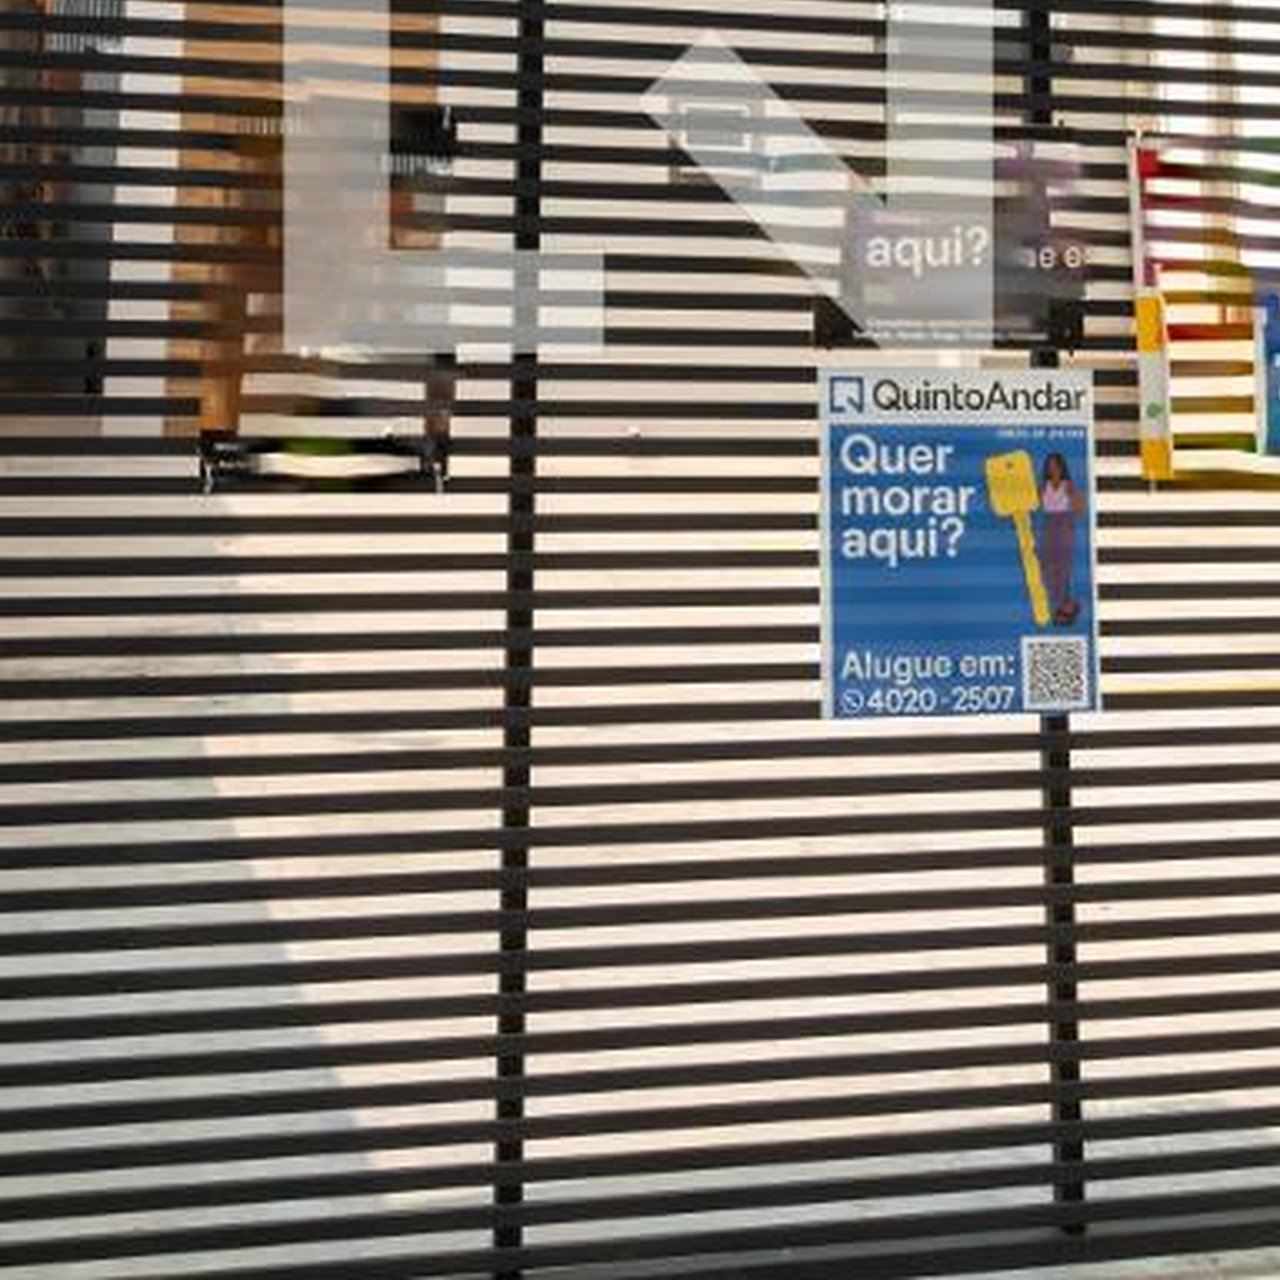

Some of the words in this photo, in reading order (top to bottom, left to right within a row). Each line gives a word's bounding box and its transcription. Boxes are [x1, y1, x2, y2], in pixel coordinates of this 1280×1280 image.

[866, 225, 989, 278] aqui?
[872, 378, 1086, 412] QuintoAndar
[840, 433, 954, 475] Quer
[841, 485, 977, 517] morar
[841, 517, 965, 568] aqui?
[841, 649, 953, 686] Alugue
[959, 653, 1016, 678] em:
